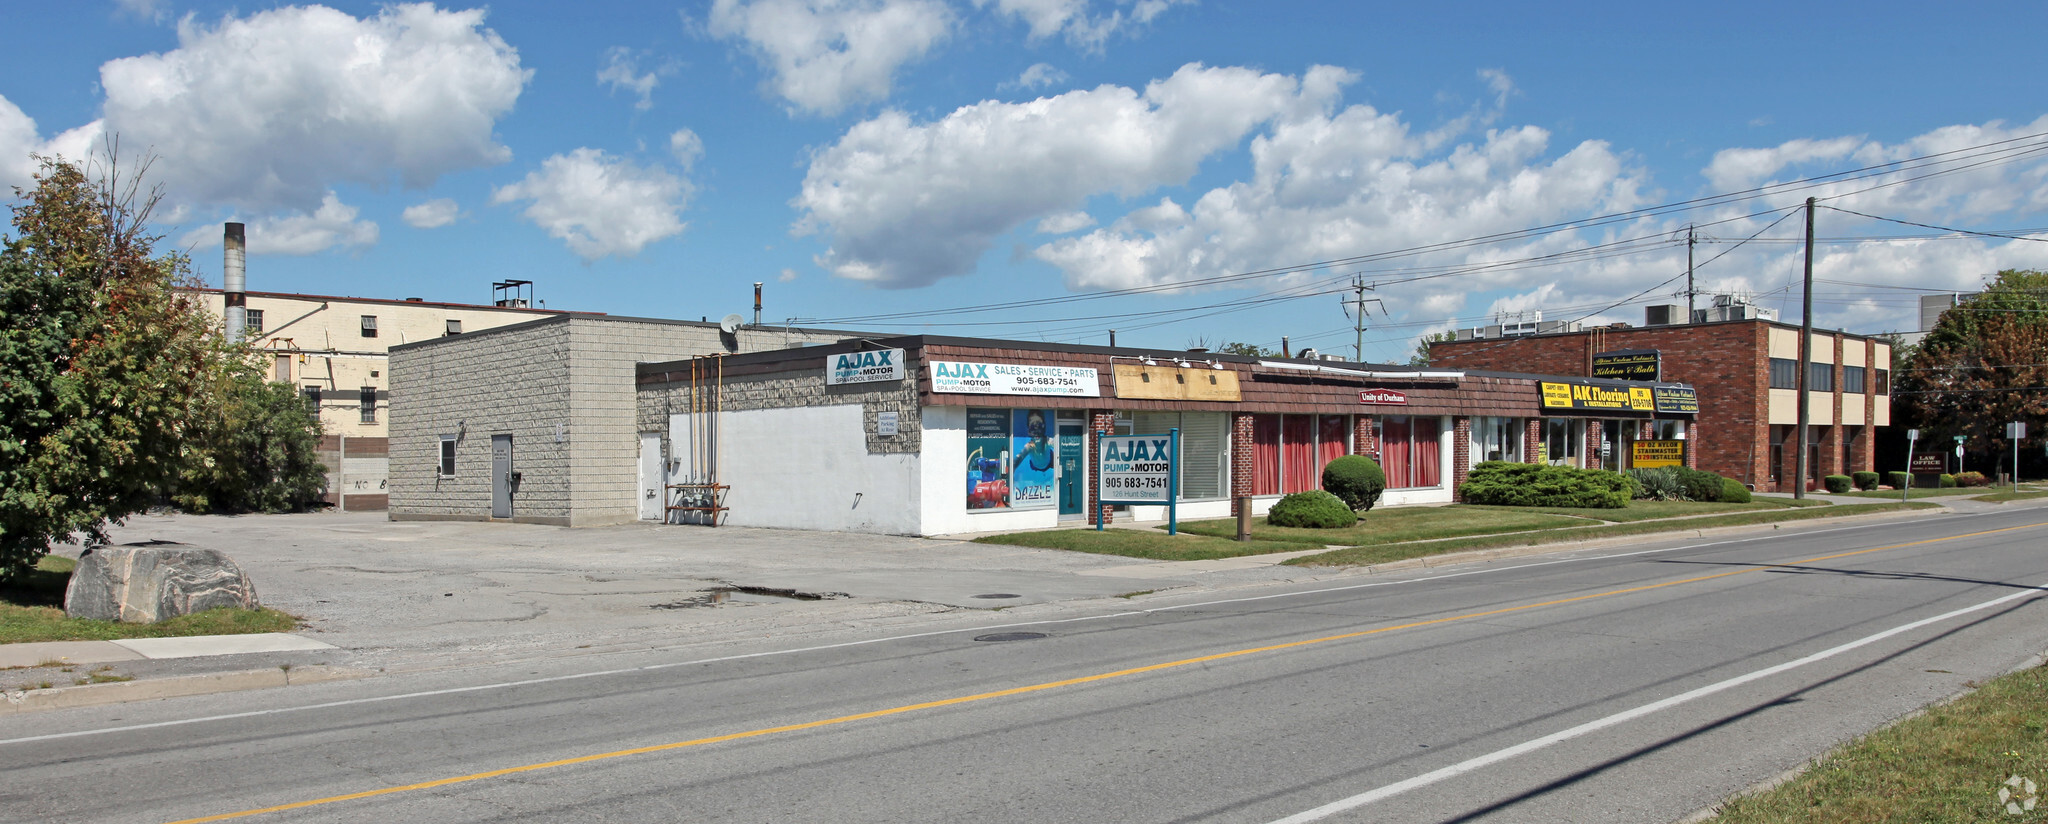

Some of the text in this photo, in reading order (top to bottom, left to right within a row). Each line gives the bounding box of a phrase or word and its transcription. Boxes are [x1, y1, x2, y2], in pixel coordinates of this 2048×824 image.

[836, 351, 892, 370] AJAX
[936, 363, 990, 378] AJAX
[995, 366, 1094, 378] SALES SERVICE PARTS
[1594, 367, 1624, 375] Kitchen
[1634, 365, 1656, 373] Bath
[1016, 376, 1078, 386] 905-683-7541
[1011, 386, 1084, 394] www.ajaxpump.com
[1574, 385, 1630, 406] AK Flooring
[1362, 392, 1404, 403] Unity of Durham
[1105, 440, 1168, 462] AJAX
[1106, 478, 1167, 488] 905 683-7541
[1016, 485, 1052, 500] DAZZLE
